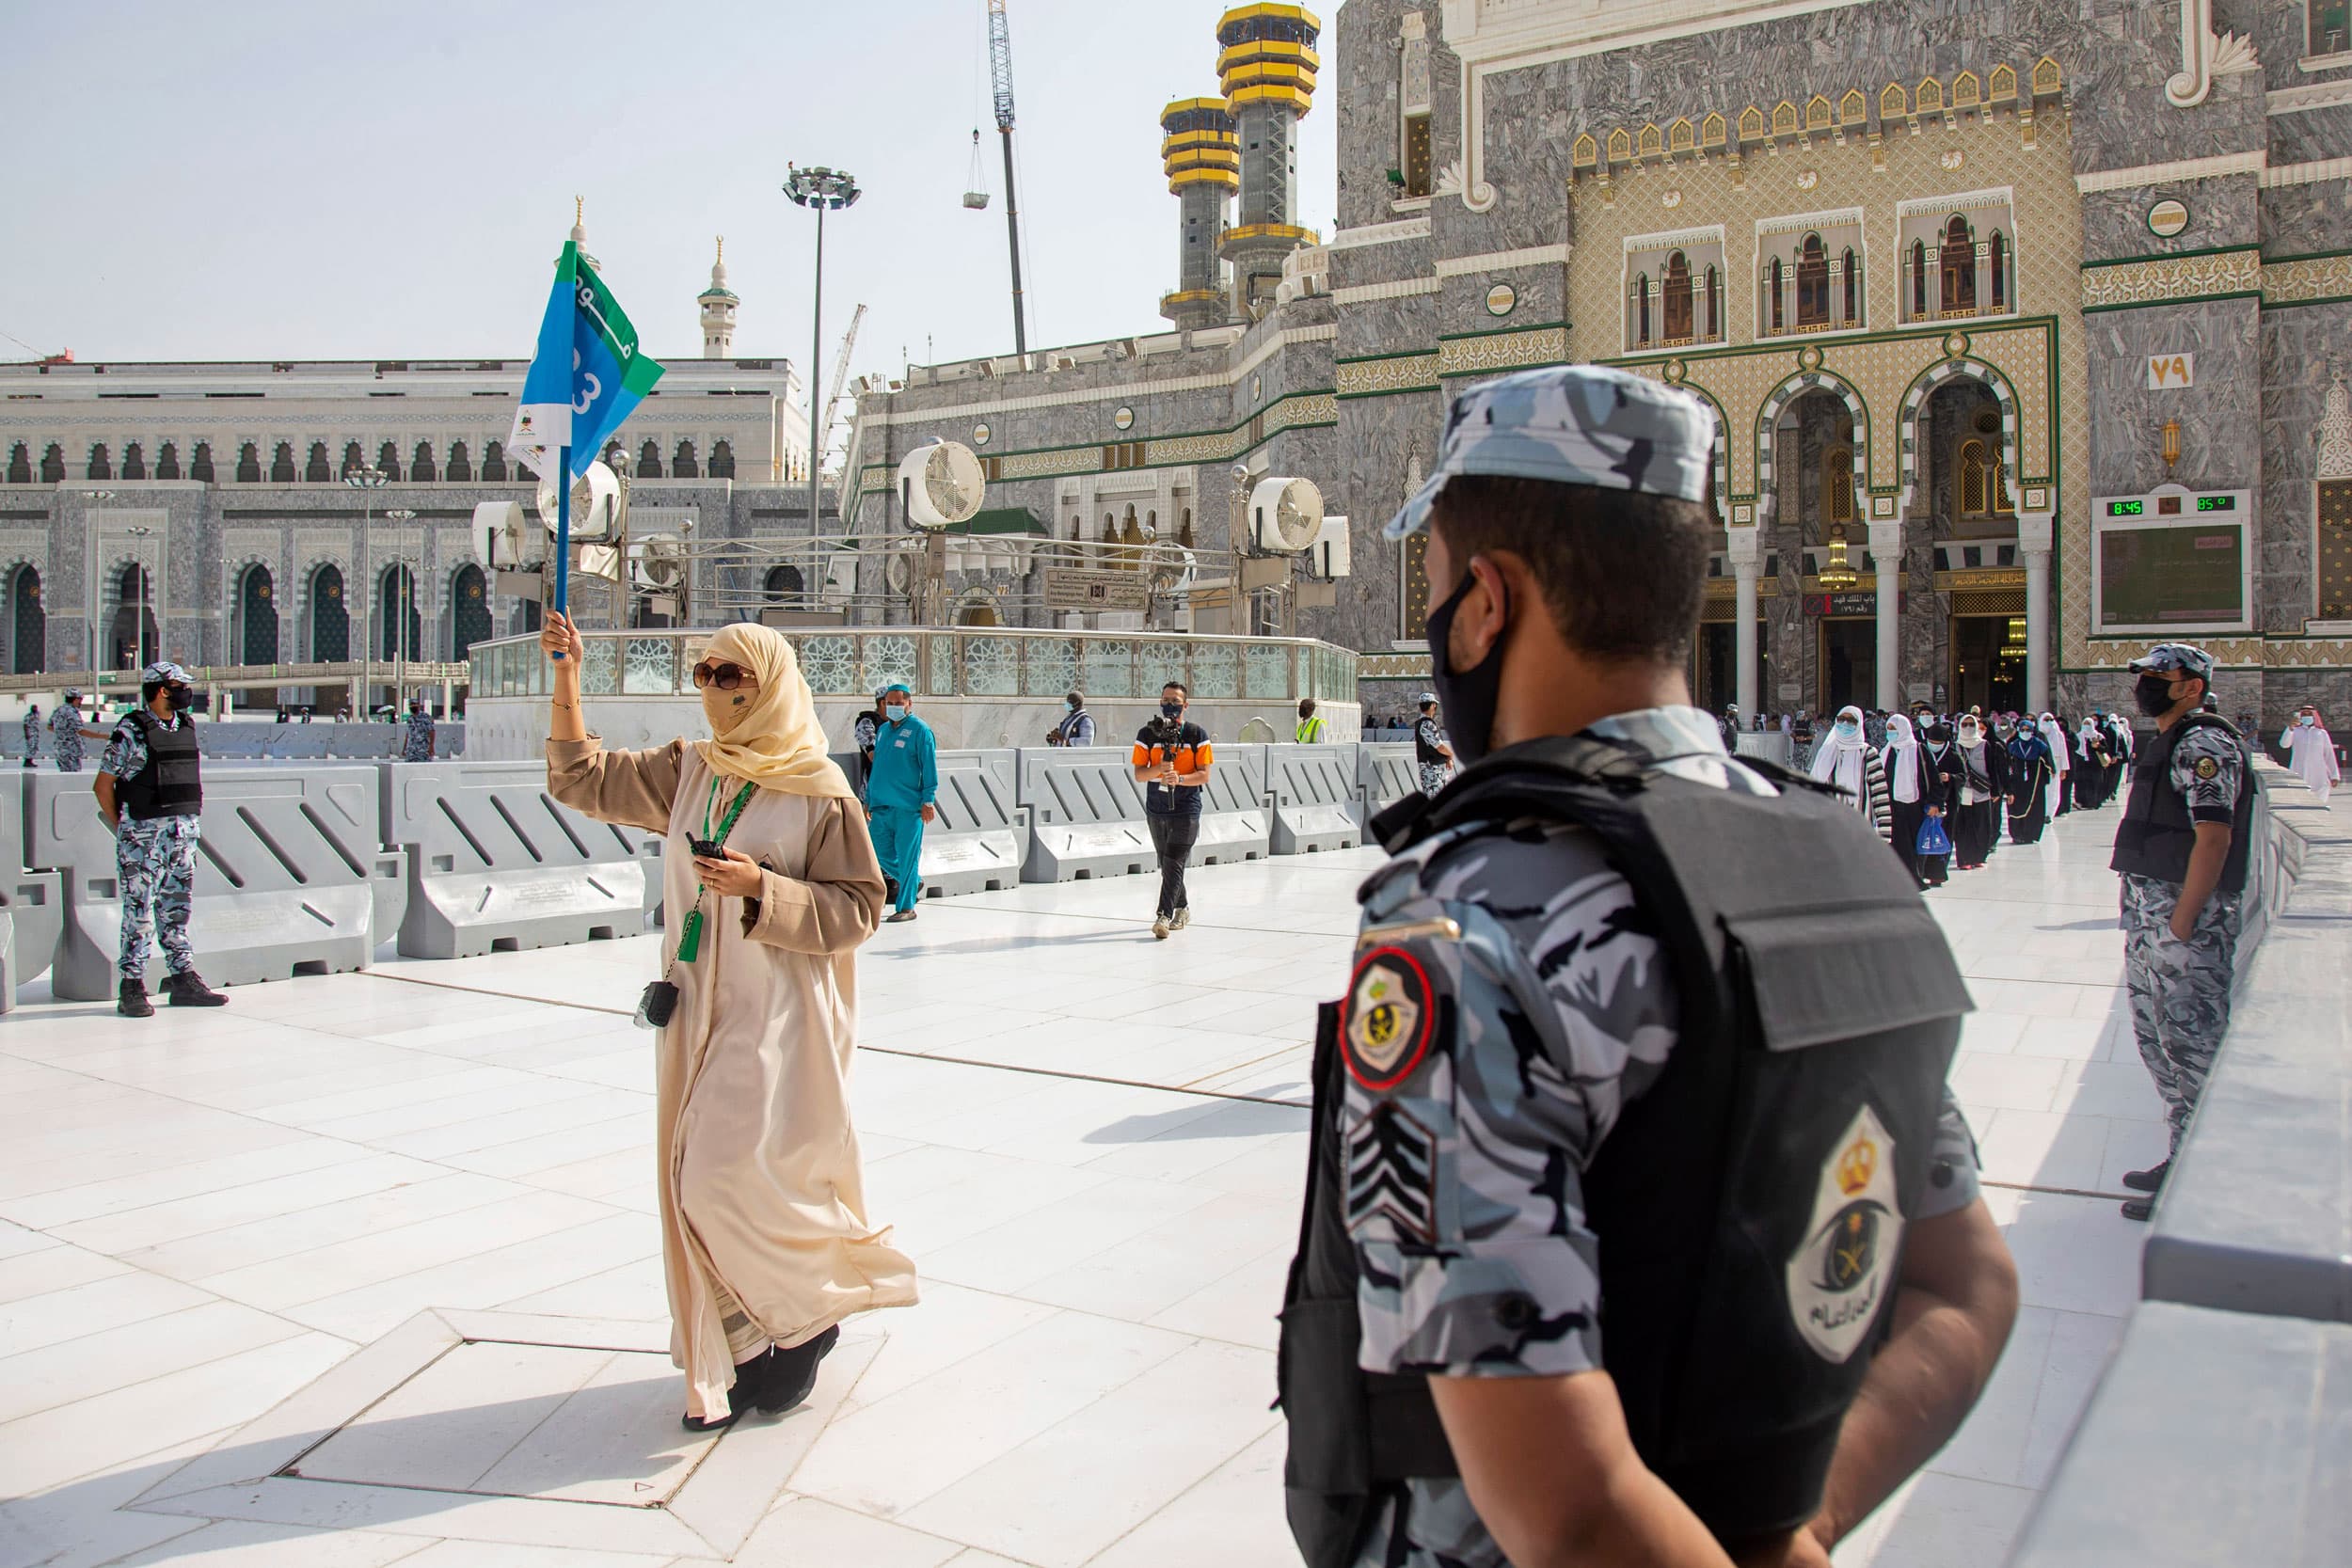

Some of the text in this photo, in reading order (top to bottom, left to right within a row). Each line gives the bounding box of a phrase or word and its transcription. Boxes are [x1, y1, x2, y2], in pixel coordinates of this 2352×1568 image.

[2152, 356, 2189, 387] ٧٩
[2114, 502, 2141, 515] 8:45
[1834, 594, 1875, 604] باب الملك فهد
[1856, 605, 1867, 613] رقم
